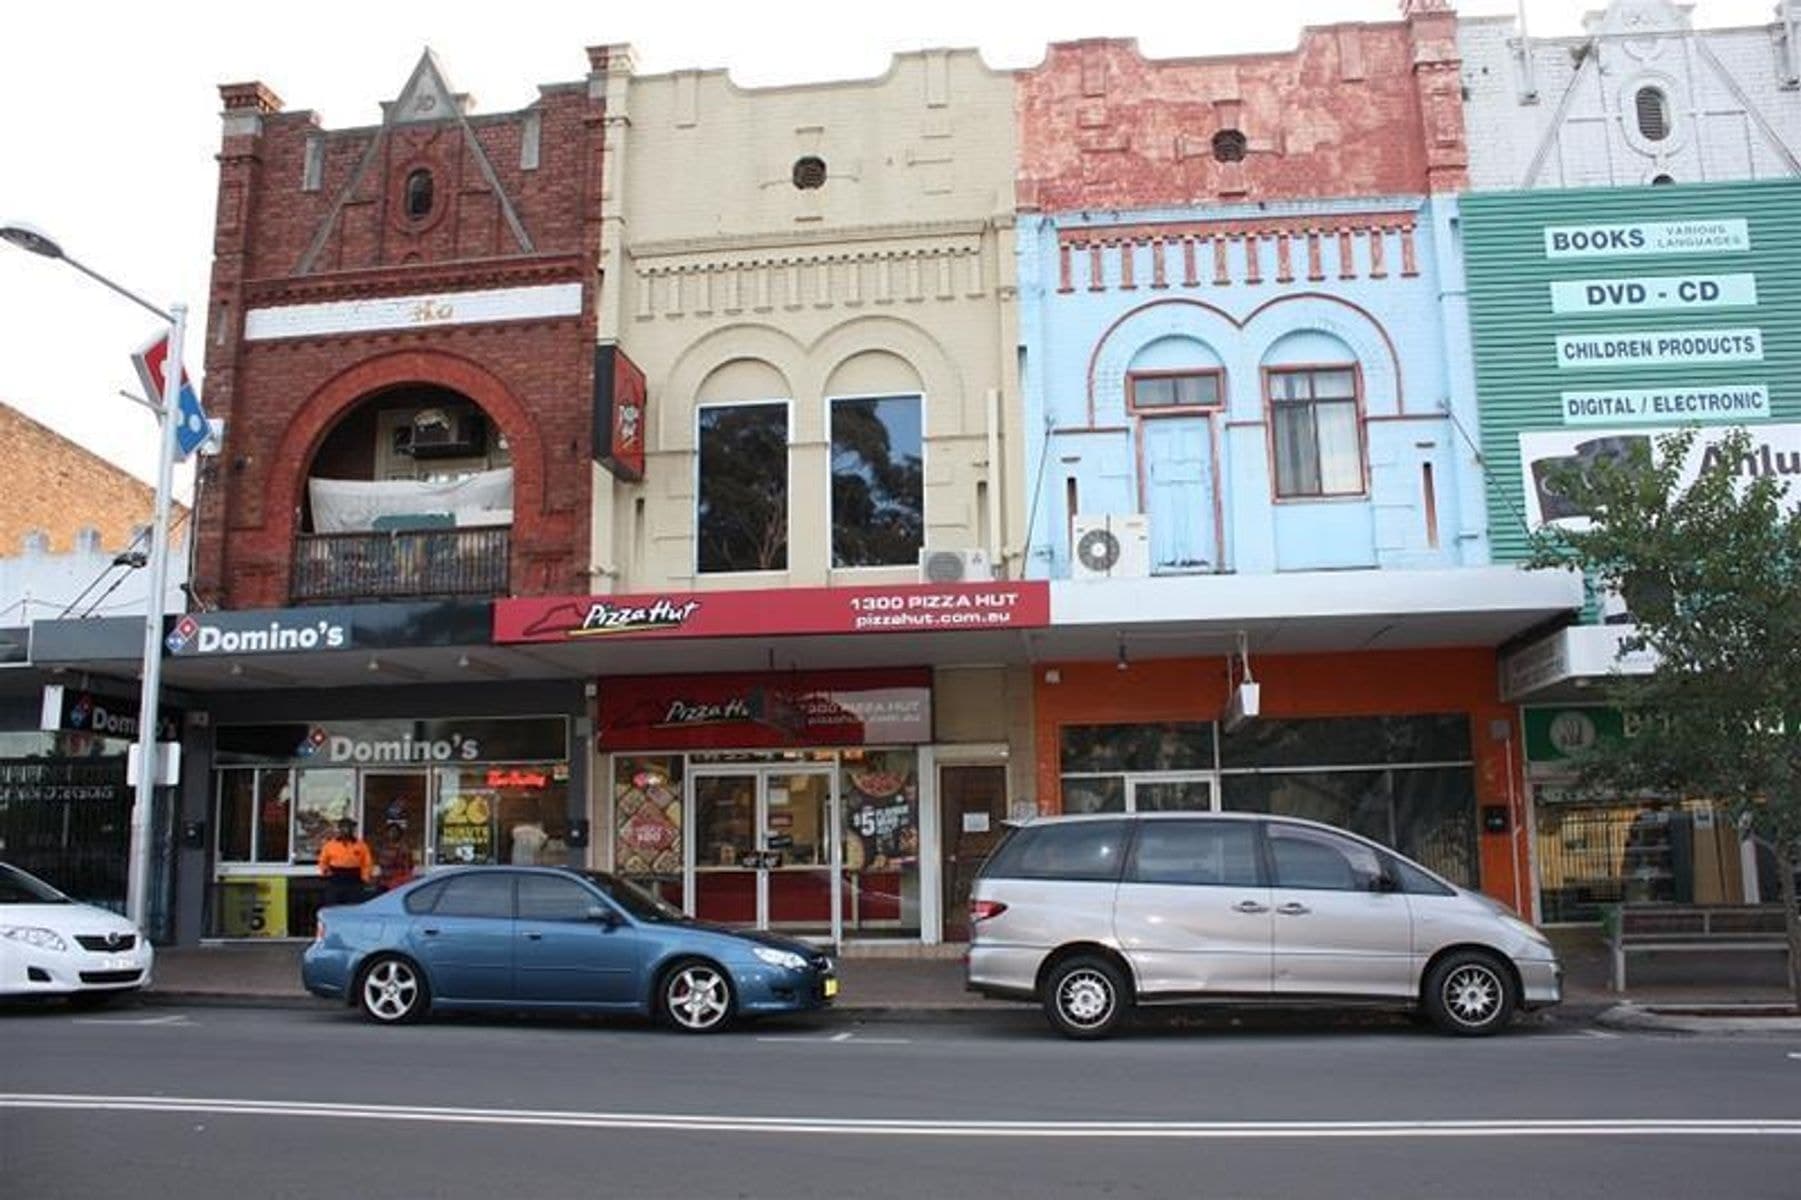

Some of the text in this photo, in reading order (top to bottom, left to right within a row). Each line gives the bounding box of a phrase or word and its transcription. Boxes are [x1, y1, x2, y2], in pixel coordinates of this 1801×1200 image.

[1552, 228, 1645, 251] BOOKS
[1658, 236, 1742, 249] LANGUAGES
[1666, 225, 1727, 236] VARIOUS
[1586, 283, 1646, 306] DVD
[1678, 280, 1720, 302] CD
[1564, 336, 1755, 360] CHILDREN PRODUCTS
[1568, 397, 1636, 416] DIGITAL
[1654, 391, 1763, 413] ELECTRONIC
[851, 592, 1019, 611] 1300 PIZZA HUT
[583, 599, 702, 630] Pizza Hut
[856, 611, 1011, 629] pizzahut.com.au
[198, 621, 344, 651] Domino's
[330, 732, 479, 762] Domino's
